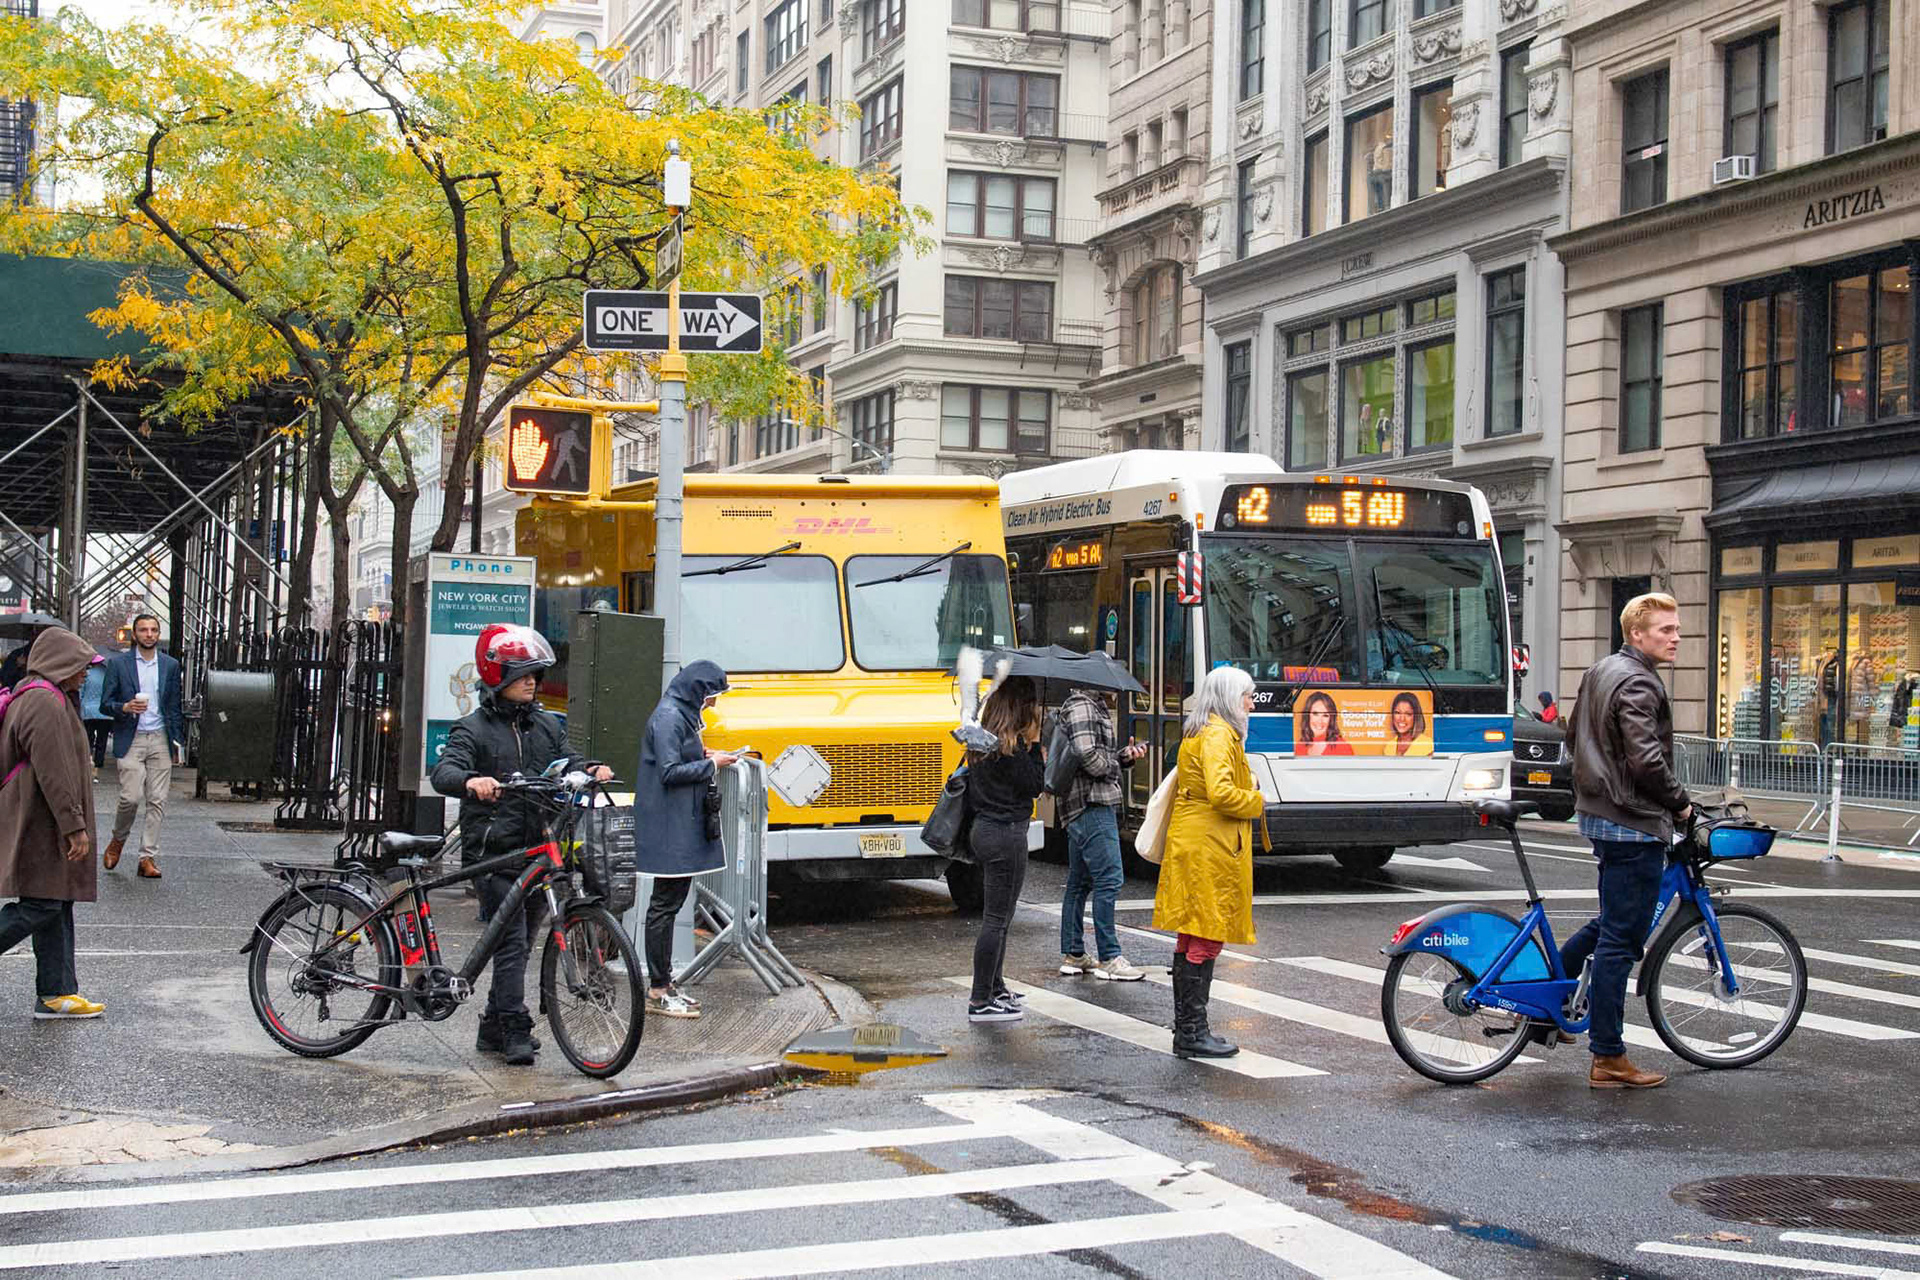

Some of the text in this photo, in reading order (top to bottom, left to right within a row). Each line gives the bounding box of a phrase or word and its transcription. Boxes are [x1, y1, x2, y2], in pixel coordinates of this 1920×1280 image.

[1803, 185, 1885, 228] ARITZIA
[602, 310, 738, 333] ONE WAY
[1007, 499, 1111, 527] Clean Air Hybrid Electric Bus
[1143, 499, 1163, 516] 4267
[1342, 491, 1363, 525] 5
[794, 518, 878, 534] DHL
[1081, 545, 1089, 564] 5
[450, 560, 513, 573] Phone
[438, 591, 527, 604] NEW YORK CITY
[438, 603, 470, 611] JEWELRY
[454, 622, 487, 631] NYCJAW
[1770, 657, 1798, 675] THE
[1285, 667, 1337, 682] Limited
[1770, 677, 1818, 695] SUPER
[1252, 692, 1274, 703] 267
[1770, 695, 1806, 714] PUFF
[1341, 709, 1367, 719] Good
[1343, 720, 1384, 728] New York
